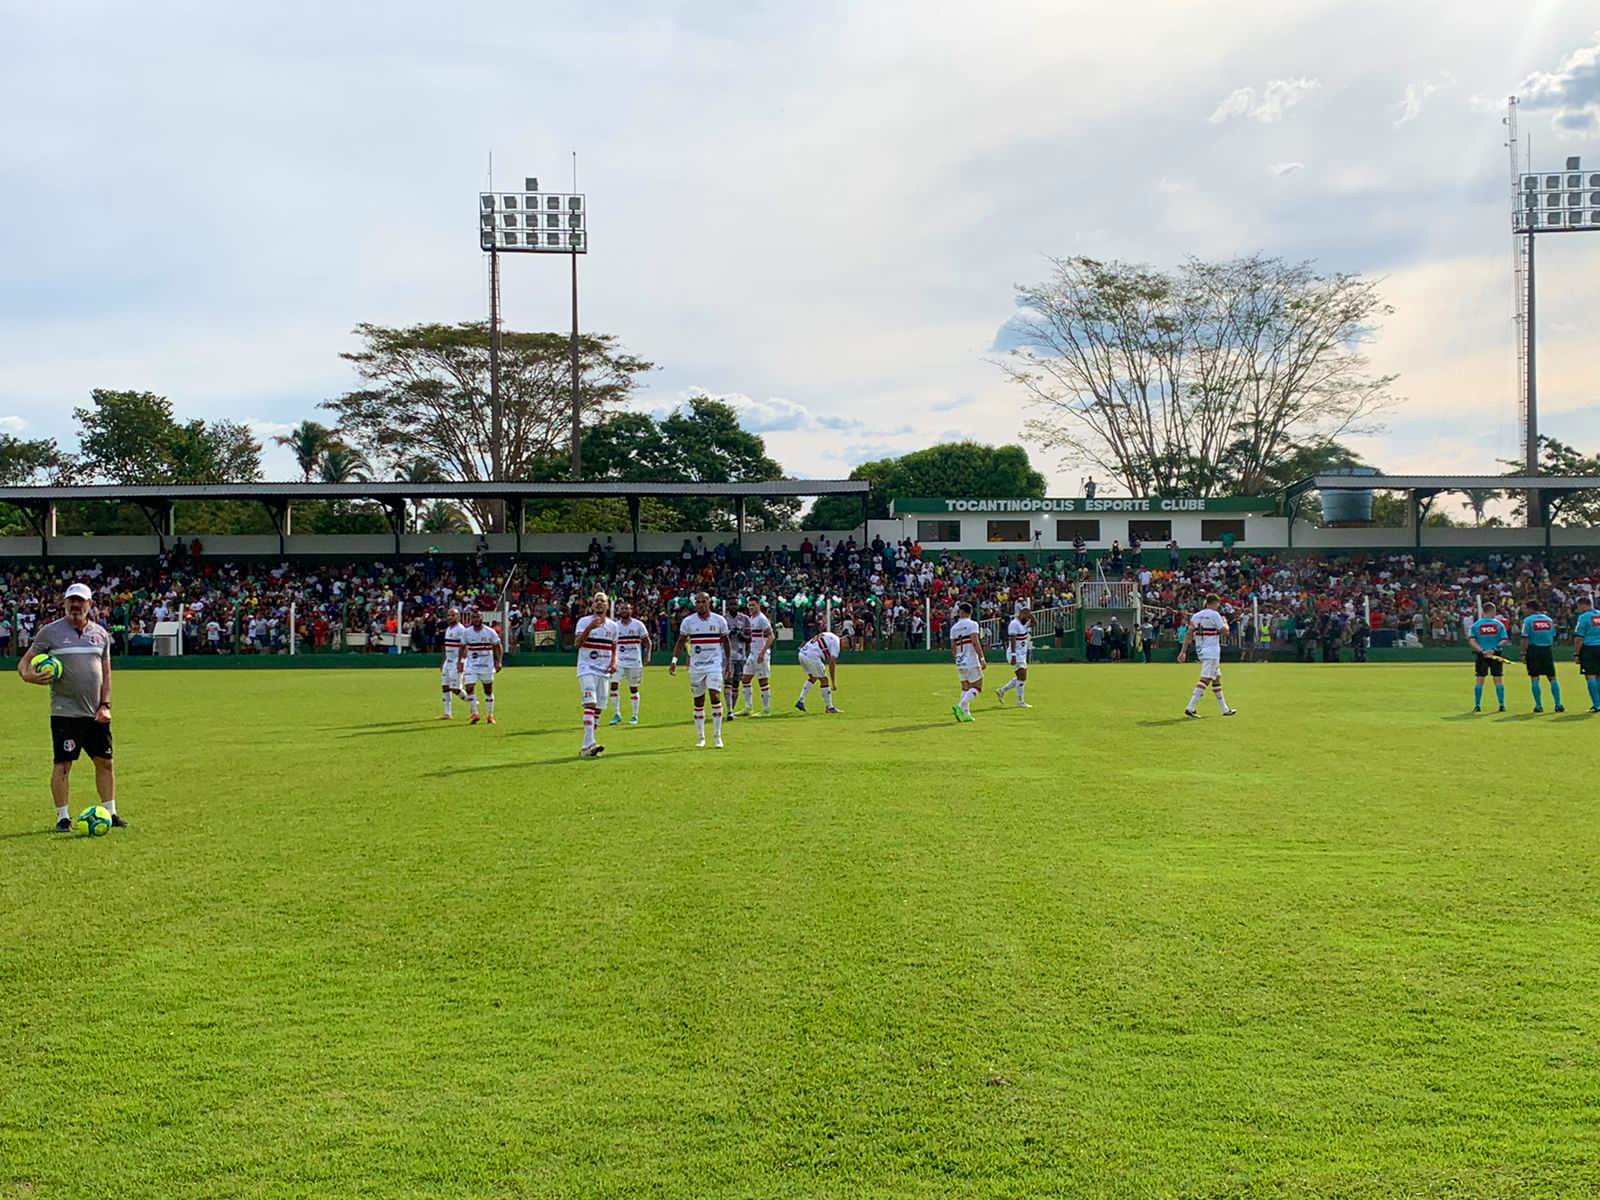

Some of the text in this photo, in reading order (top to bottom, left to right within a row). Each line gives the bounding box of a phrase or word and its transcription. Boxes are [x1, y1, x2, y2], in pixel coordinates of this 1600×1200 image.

[945, 498, 1206, 511] TOCANTINÓPOLIS ESPORTE CLUBE
